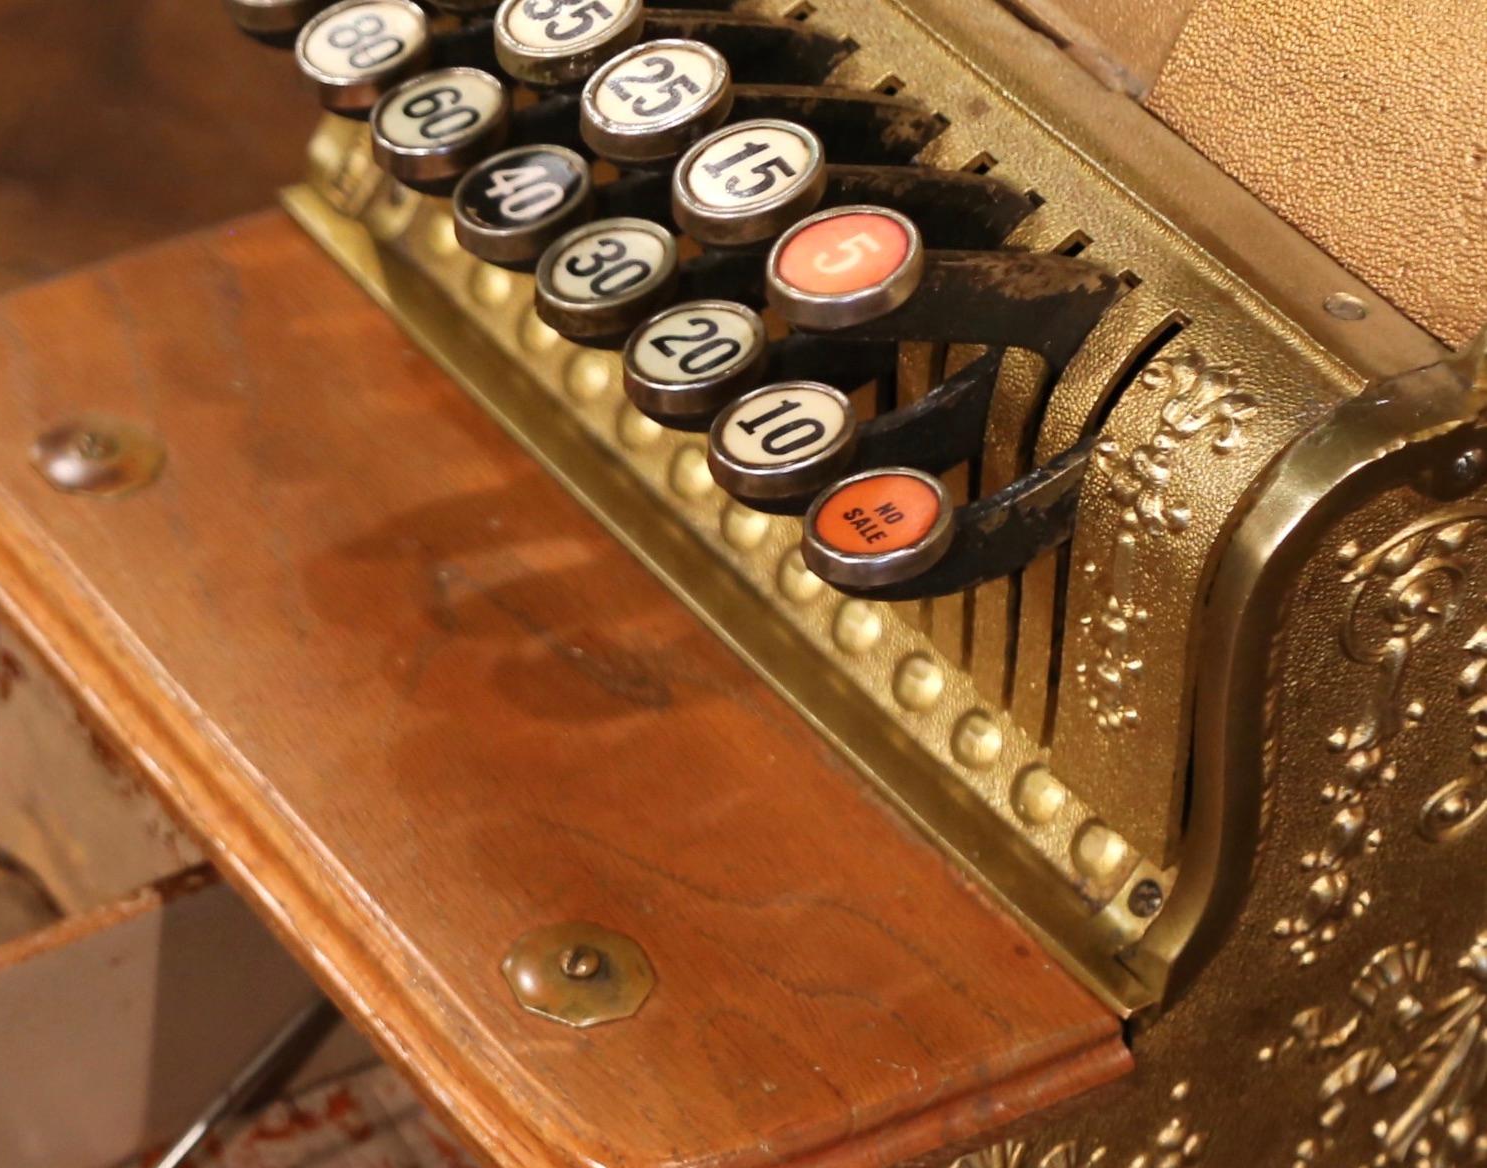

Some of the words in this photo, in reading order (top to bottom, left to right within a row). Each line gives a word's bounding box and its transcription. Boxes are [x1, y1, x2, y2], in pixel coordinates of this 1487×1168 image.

[328, 14, 405, 69] 80
[402, 86, 480, 139] 60
[605, 56, 701, 117] 25
[485, 164, 565, 221] 40
[701, 141, 797, 198] 15
[566, 238, 651, 297] 30
[814, 232, 878, 274] 5
[649, 317, 741, 375] 20
[737, 399, 825, 455] 10
[843, 507, 888, 544] SALE
[874, 502, 904, 524] NO
